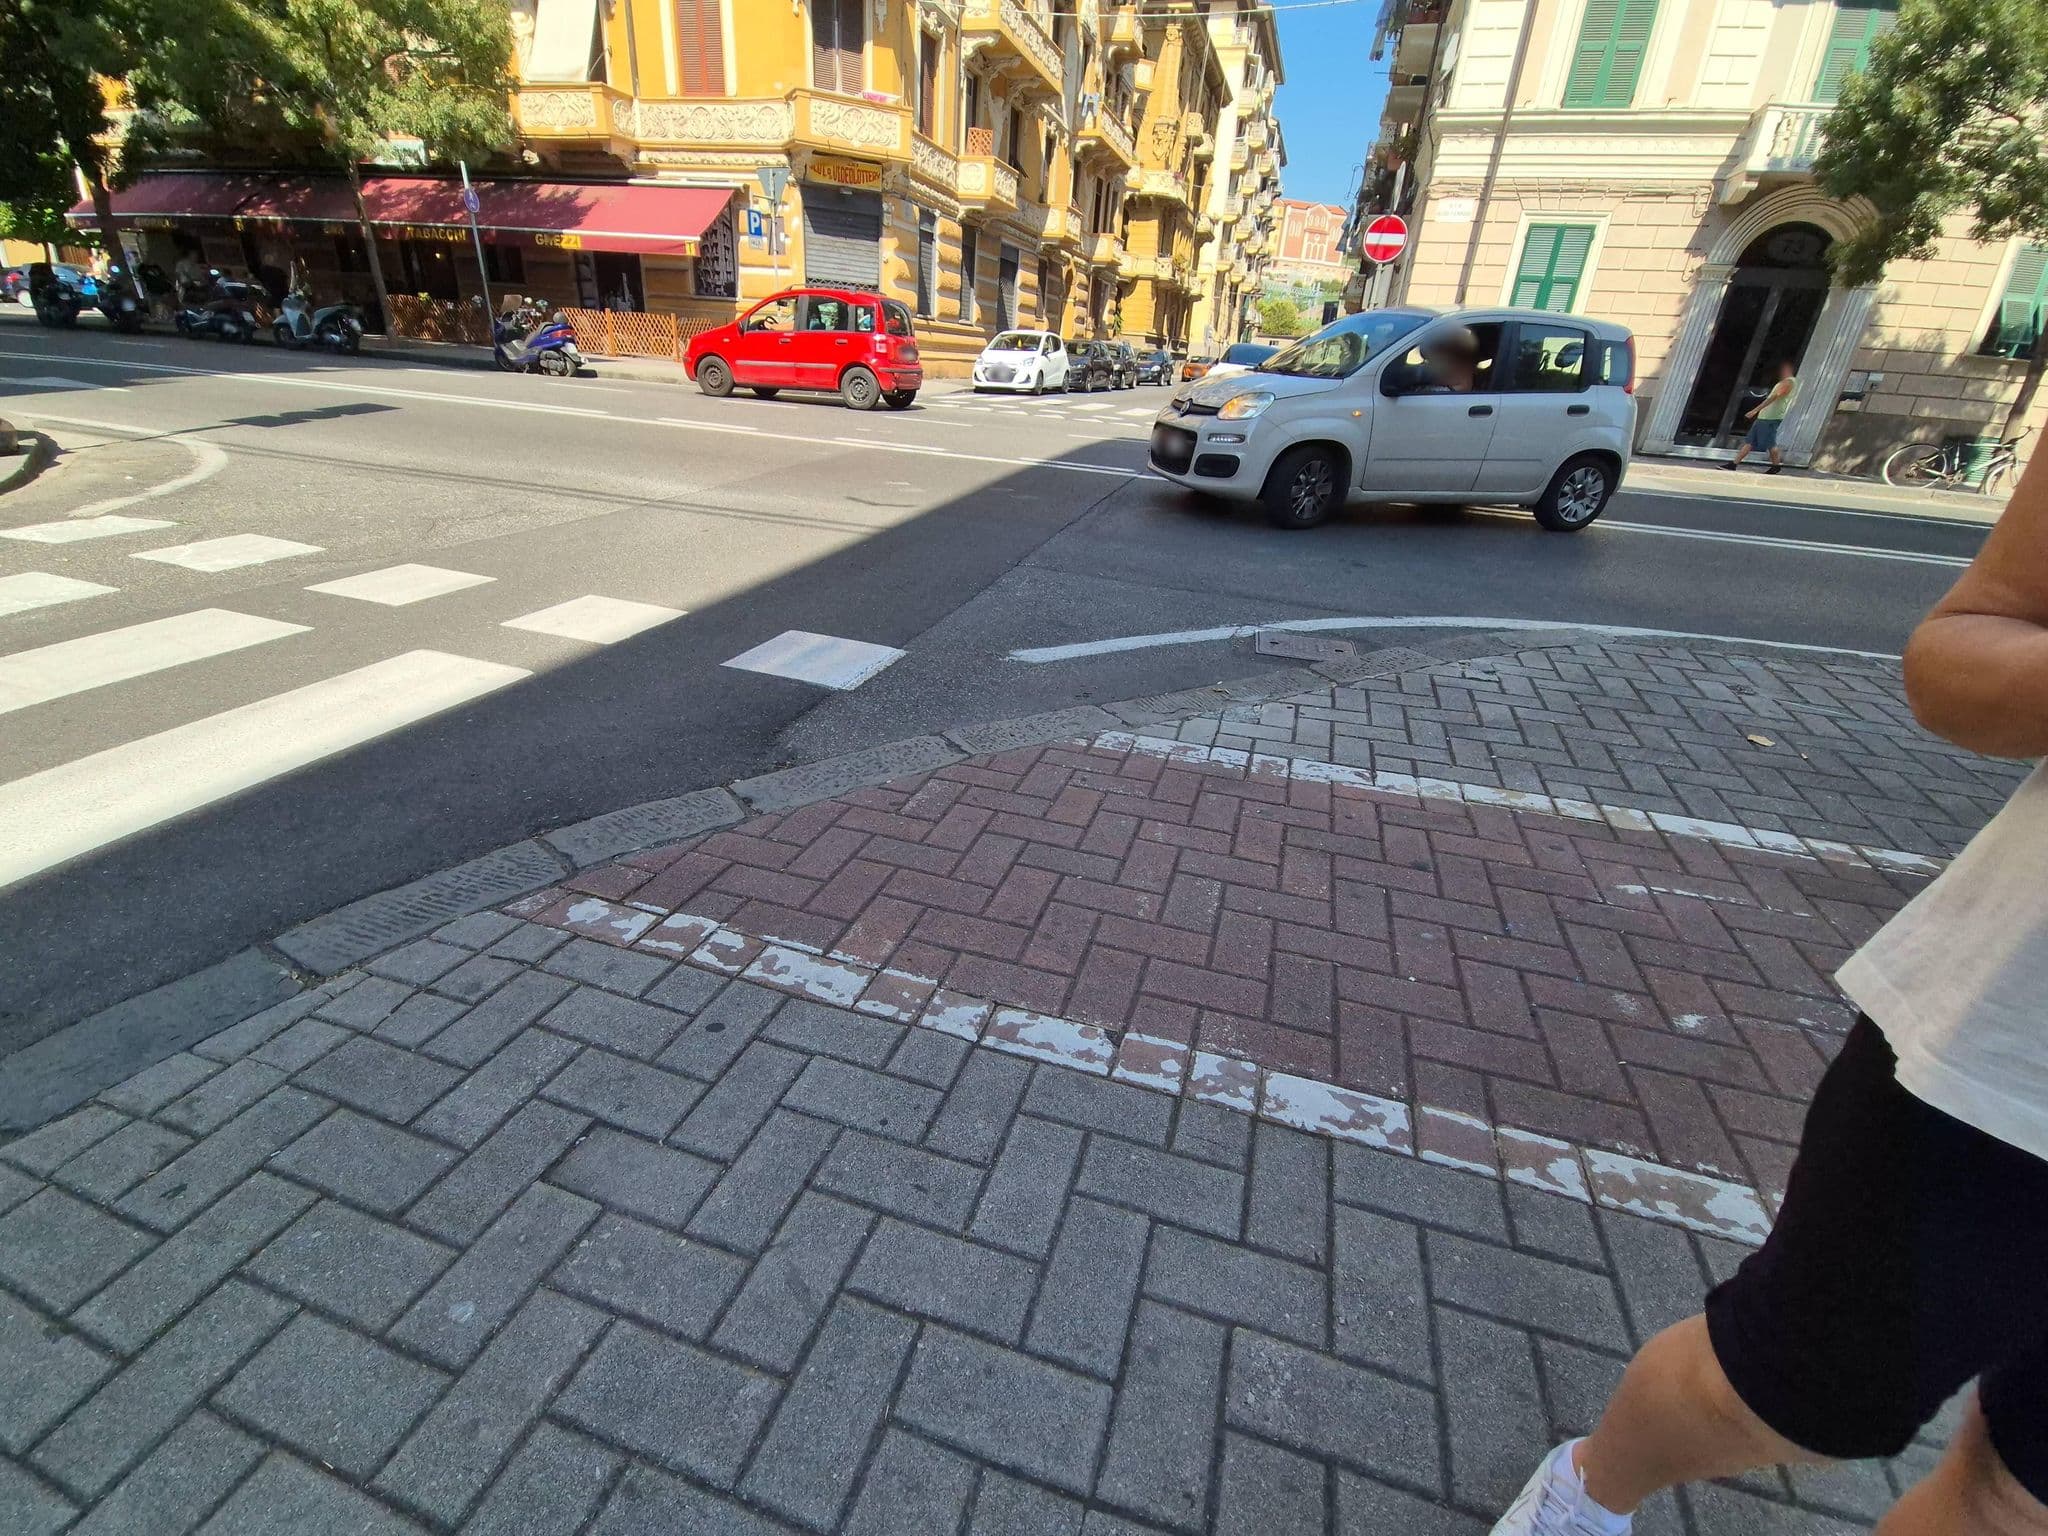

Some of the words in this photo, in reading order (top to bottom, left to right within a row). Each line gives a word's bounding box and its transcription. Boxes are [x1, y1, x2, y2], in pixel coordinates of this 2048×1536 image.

[750, 211, 760, 234] P
[405, 226, 467, 241] TABACCHI
[535, 233, 580, 249] GHEZZI
